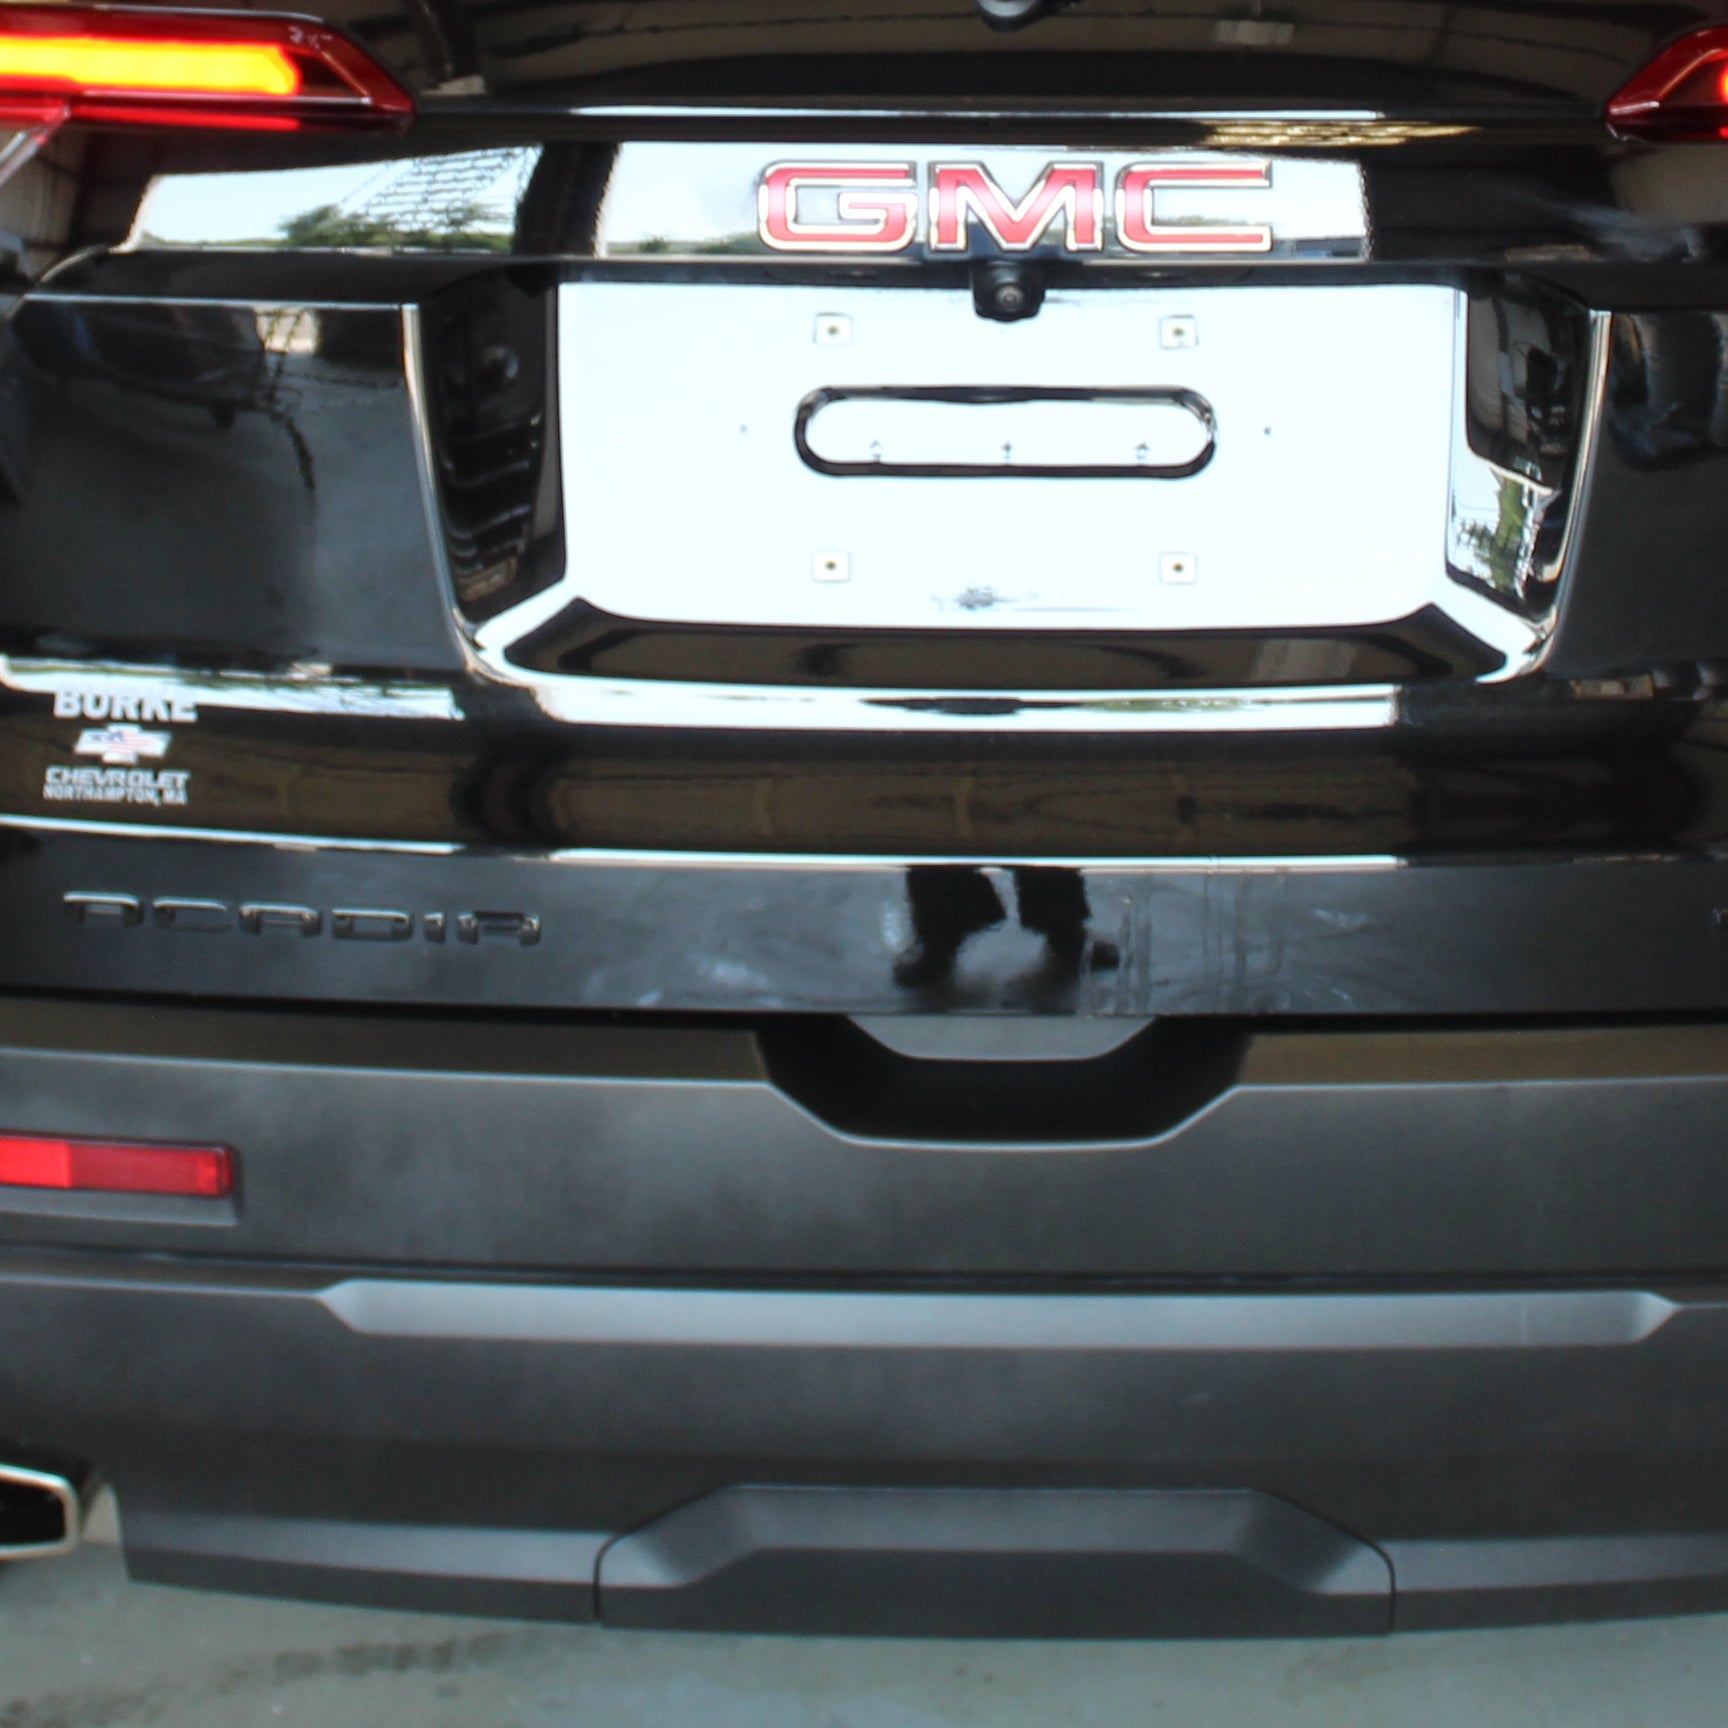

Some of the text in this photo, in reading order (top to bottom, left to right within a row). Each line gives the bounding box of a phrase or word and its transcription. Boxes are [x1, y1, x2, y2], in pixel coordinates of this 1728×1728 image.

[759, 161, 1273, 253] GMC
[53, 685, 198, 722] BURKE
[45, 766, 190, 789] CHEVROLET
[64, 891, 542, 946] ACADIA
